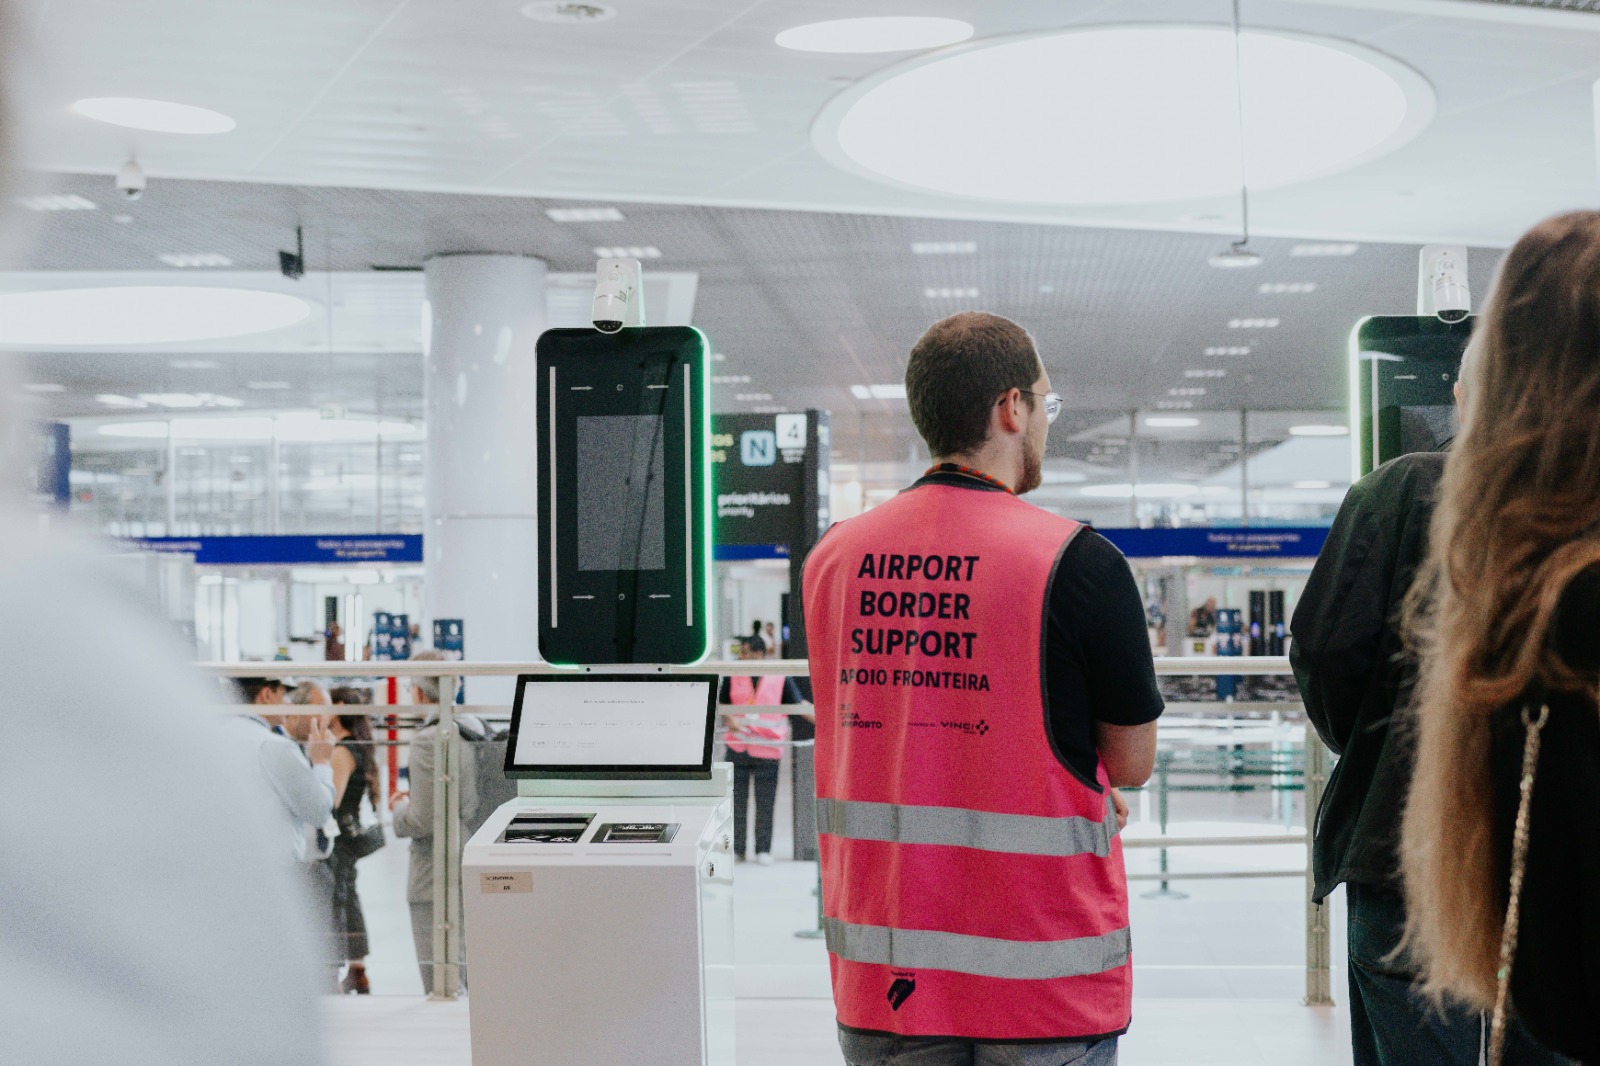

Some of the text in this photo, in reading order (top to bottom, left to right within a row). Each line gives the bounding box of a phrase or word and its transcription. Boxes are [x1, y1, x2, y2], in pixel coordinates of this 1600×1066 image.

[788, 423, 799, 439] 4
[749, 438, 768, 458] N
[857, 553, 980, 581] AIRPORT
[860, 590, 971, 619] BORDER
[851, 628, 977, 659] SUPPORT
[840, 668, 990, 692] APOIO FRONTEIRA
[940, 721, 975, 731] VINCI
